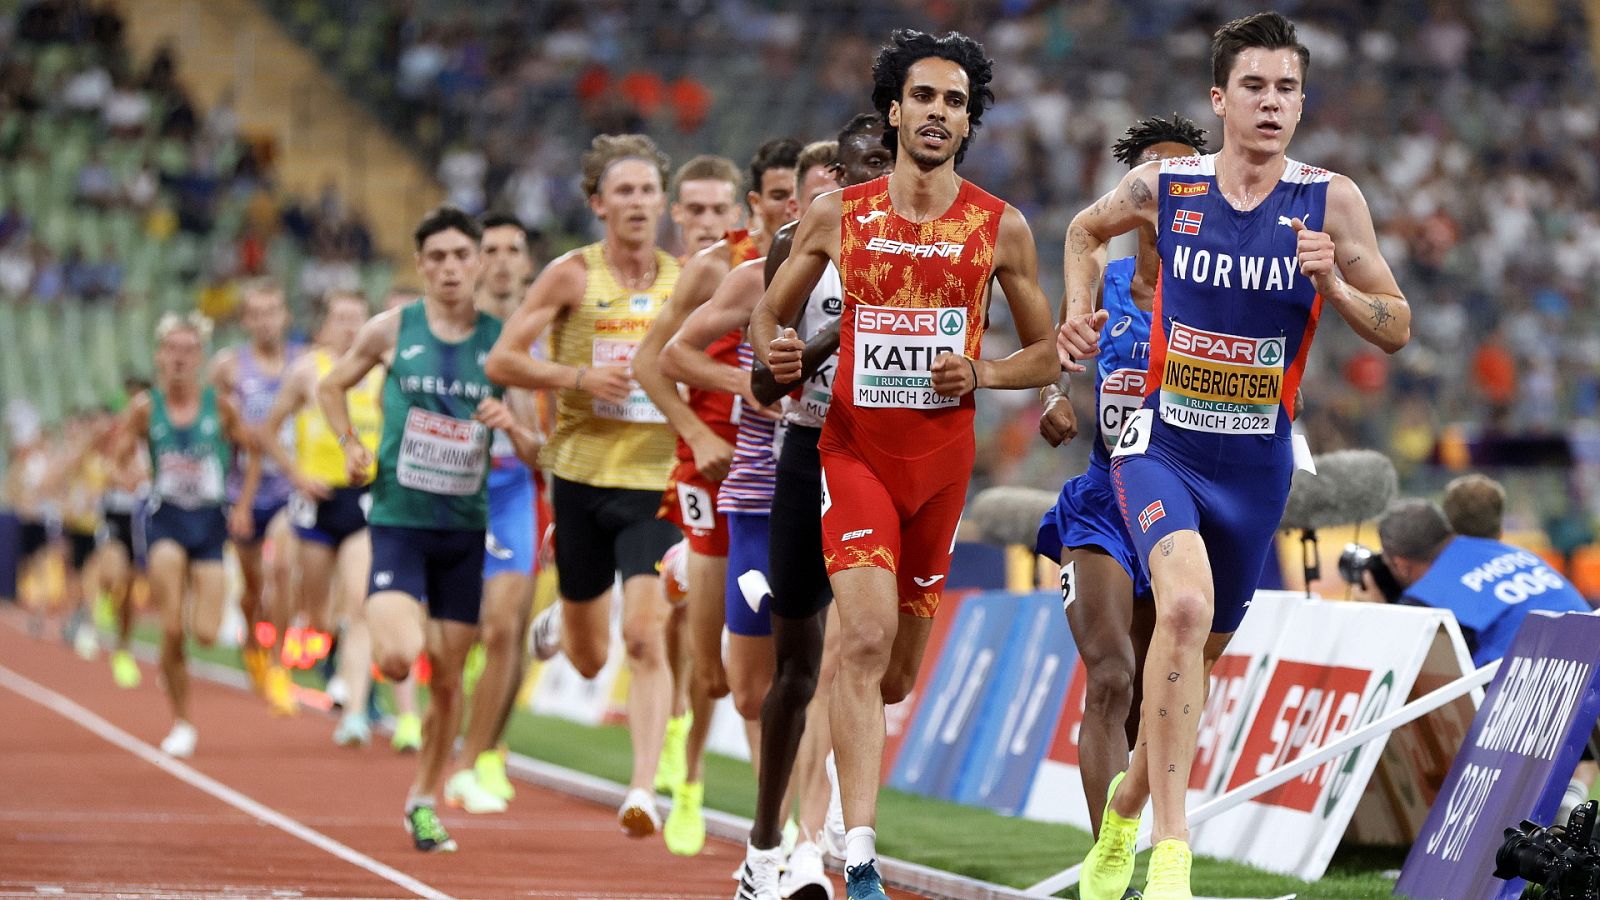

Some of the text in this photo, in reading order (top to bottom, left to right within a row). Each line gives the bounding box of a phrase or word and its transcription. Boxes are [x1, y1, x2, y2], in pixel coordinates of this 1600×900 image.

[865, 237, 965, 258] ESPAÑA
[1173, 245, 1298, 291] NORWAY
[859, 311, 935, 333] SPAR
[1173, 329, 1253, 361] SPAR
[881, 377, 902, 386] RUN
[905, 378, 932, 387] CLEA
[1165, 360, 1280, 399] INGEBRIGTSEN
[858, 388, 917, 404] MUNICH
[1191, 399, 1213, 410] RUN
[1165, 406, 1270, 430] MUNICH 2022
[1120, 415, 1141, 448] 6
[841, 529, 873, 541] ESP
[1494, 566, 1565, 604] 006
[1426, 763, 1501, 863] SPORT
